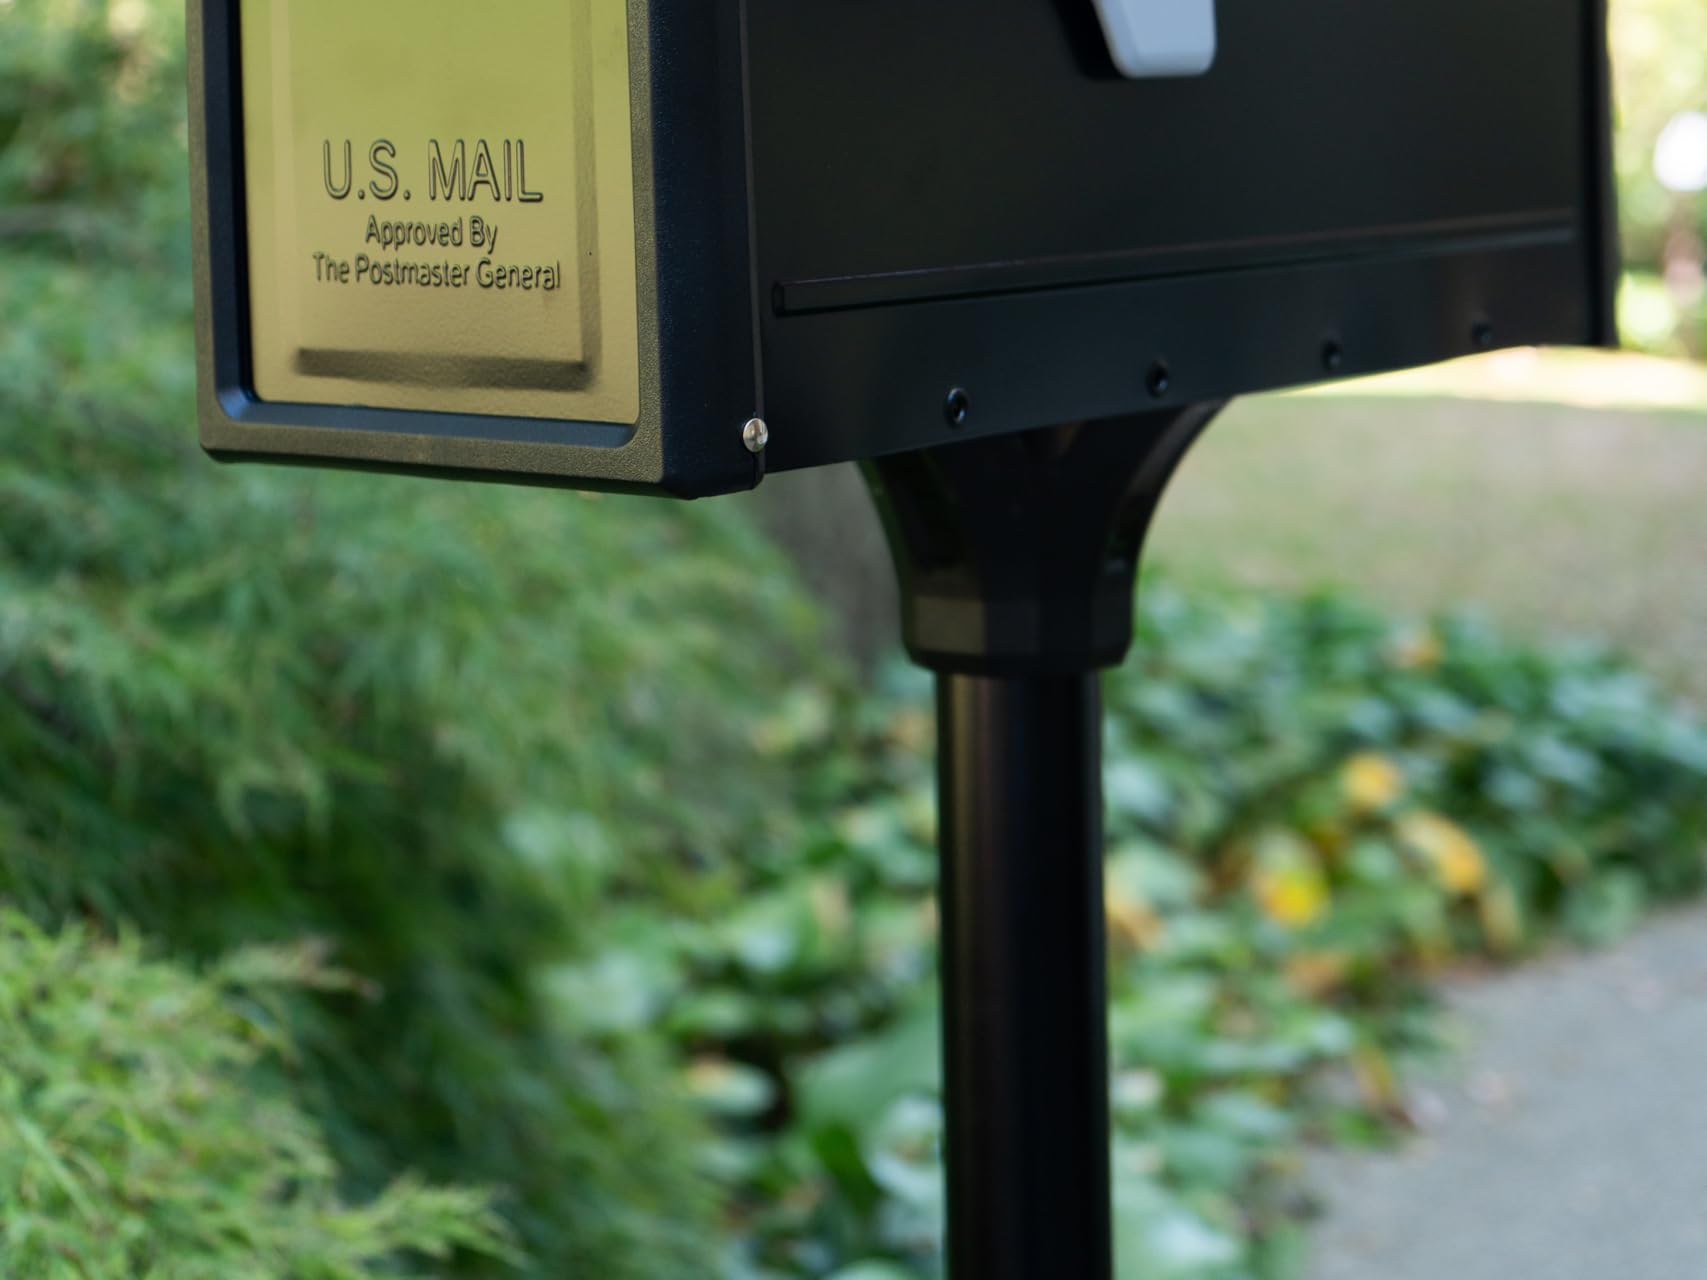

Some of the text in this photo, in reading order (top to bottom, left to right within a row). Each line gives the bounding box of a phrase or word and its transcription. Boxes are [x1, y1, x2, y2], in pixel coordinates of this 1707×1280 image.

[322, 138, 544, 203] U.S. MAIL
[365, 214, 498, 254] Approved By
[312, 251, 561, 291] The Postmaster General
